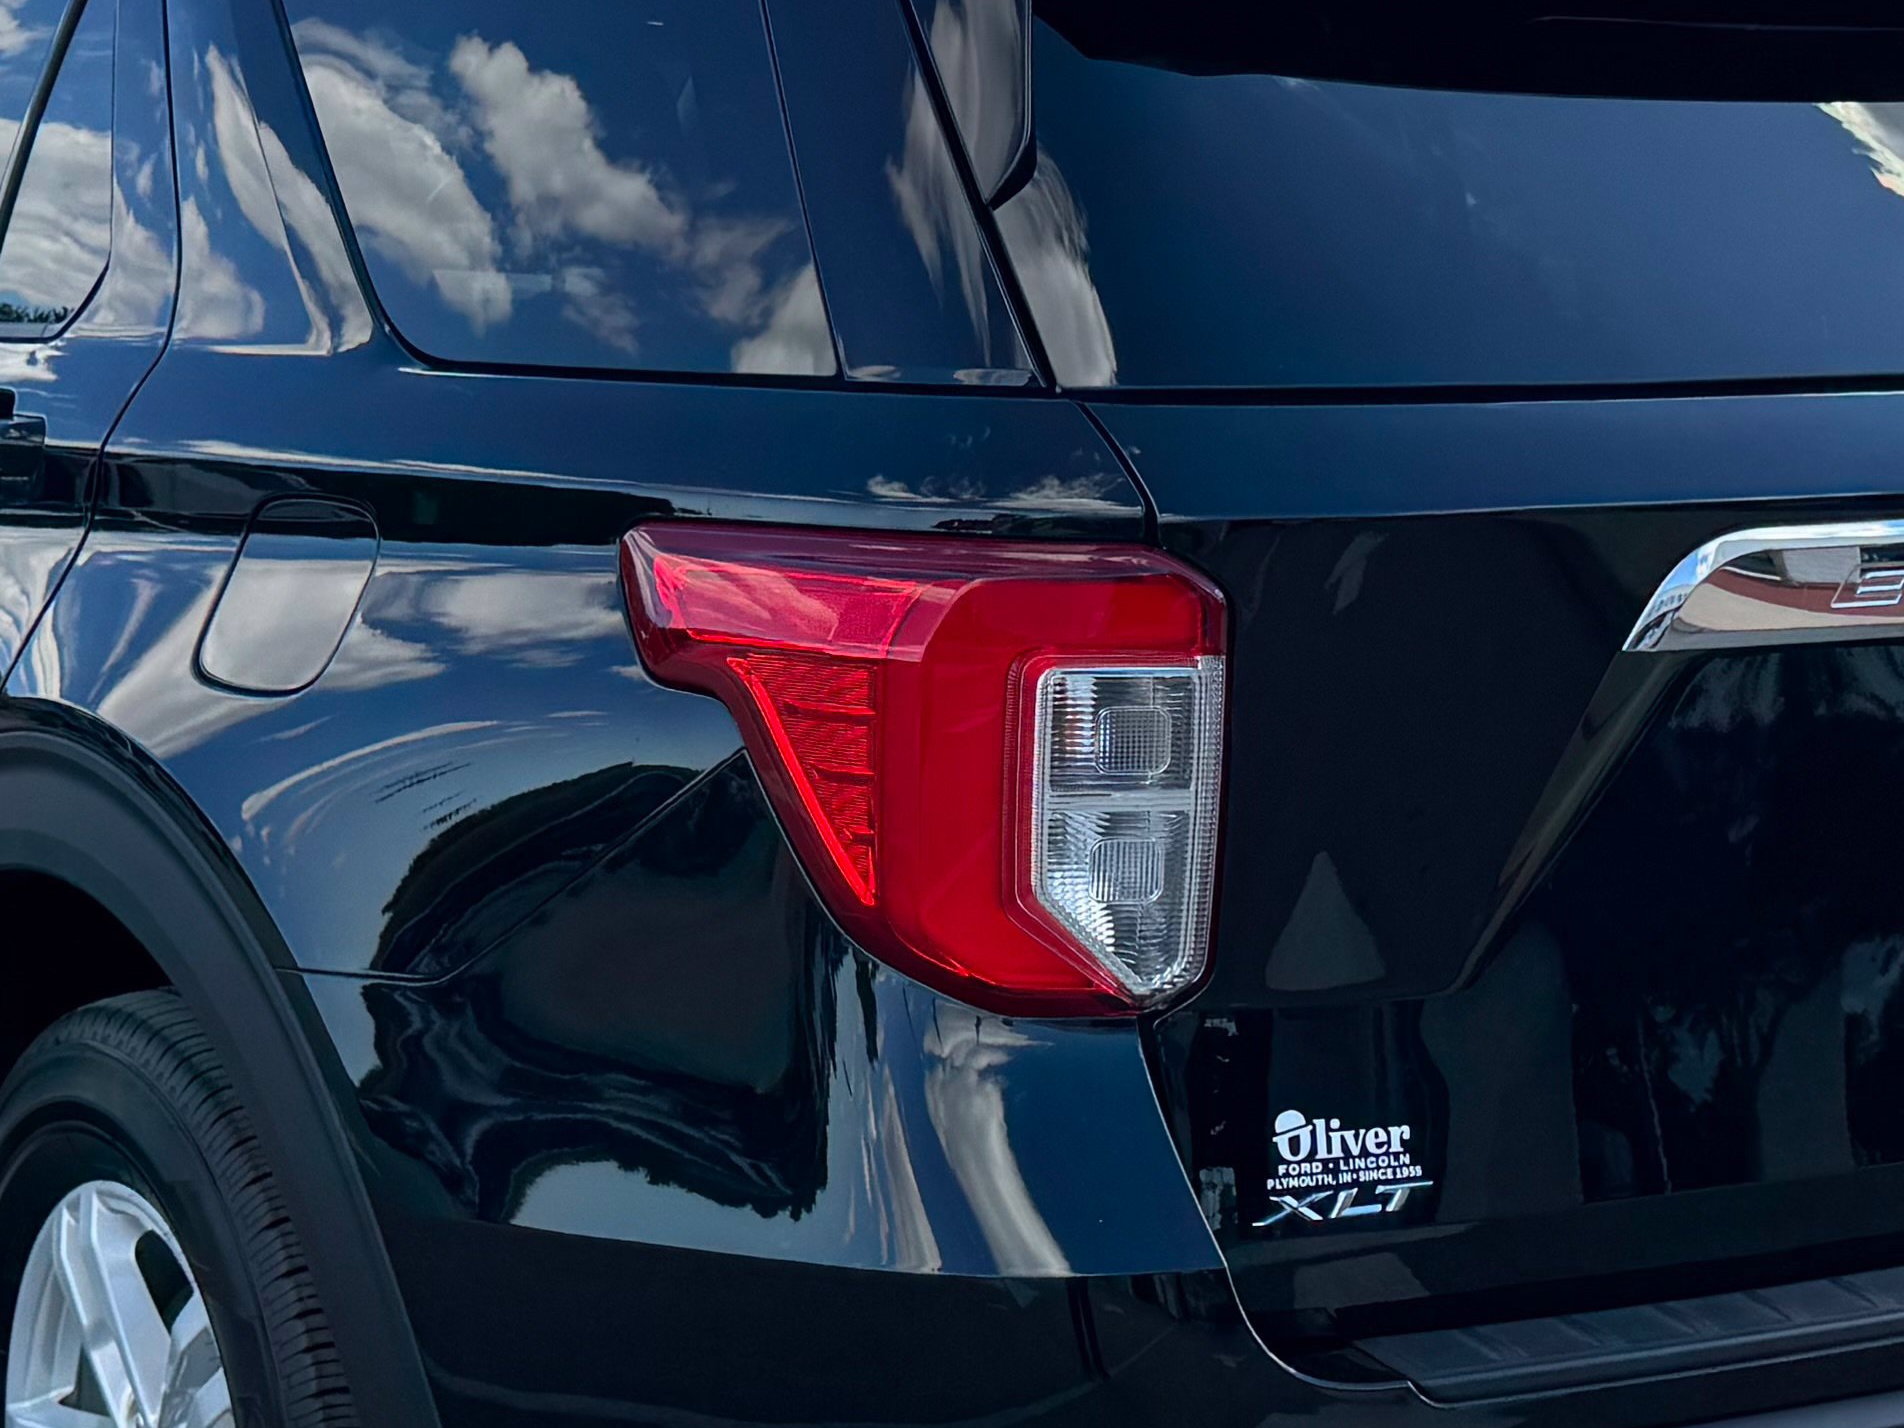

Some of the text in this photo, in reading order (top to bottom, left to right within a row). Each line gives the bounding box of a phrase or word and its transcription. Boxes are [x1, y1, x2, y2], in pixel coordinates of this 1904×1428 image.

[1272, 1109, 1411, 1162] Oliver
[1266, 1173, 1337, 1190] PLYMOUTH,
[1359, 1168, 1394, 1182] SINCE
[1278, 1153, 1411, 1176] FORD LINCOLN
[1252, 1180, 1434, 1226] XLT
